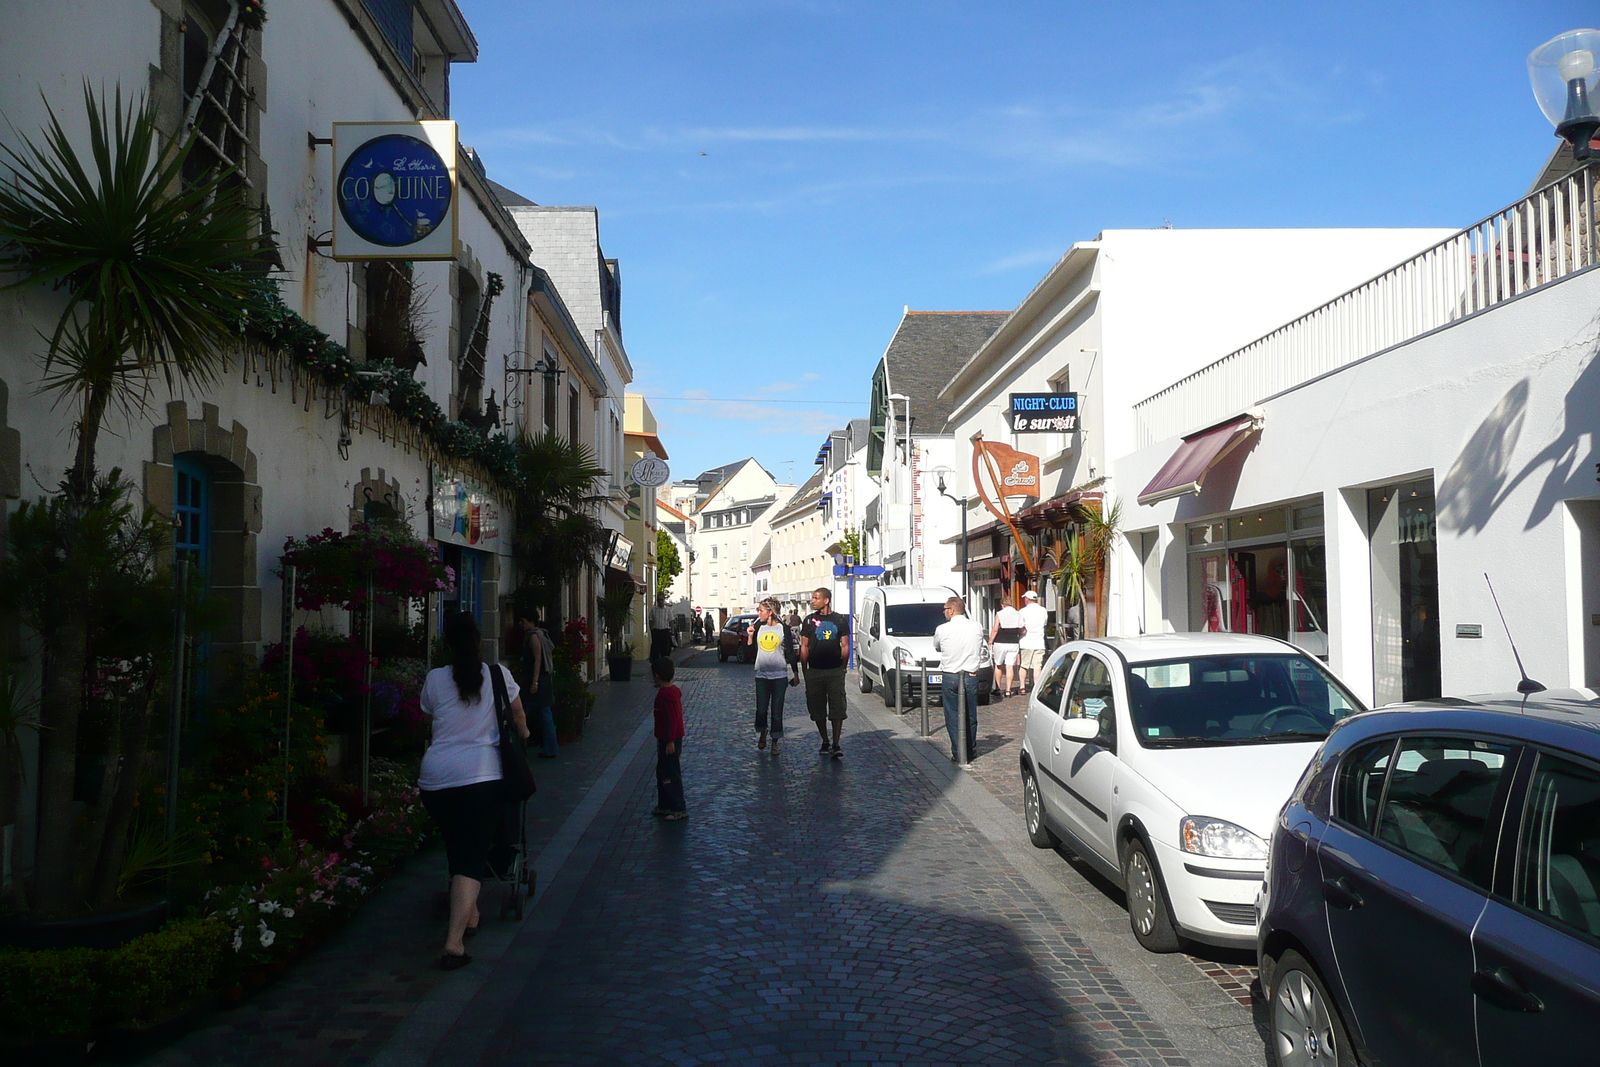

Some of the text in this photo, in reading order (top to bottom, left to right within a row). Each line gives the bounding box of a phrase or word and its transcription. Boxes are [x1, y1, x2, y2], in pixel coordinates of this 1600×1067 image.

[407, 158, 437, 171] Marie
[1013, 397, 1076, 411] NIGHT-CLUB
[1014, 414, 1028, 430] le
[835, 473, 843, 531] HOTEL
